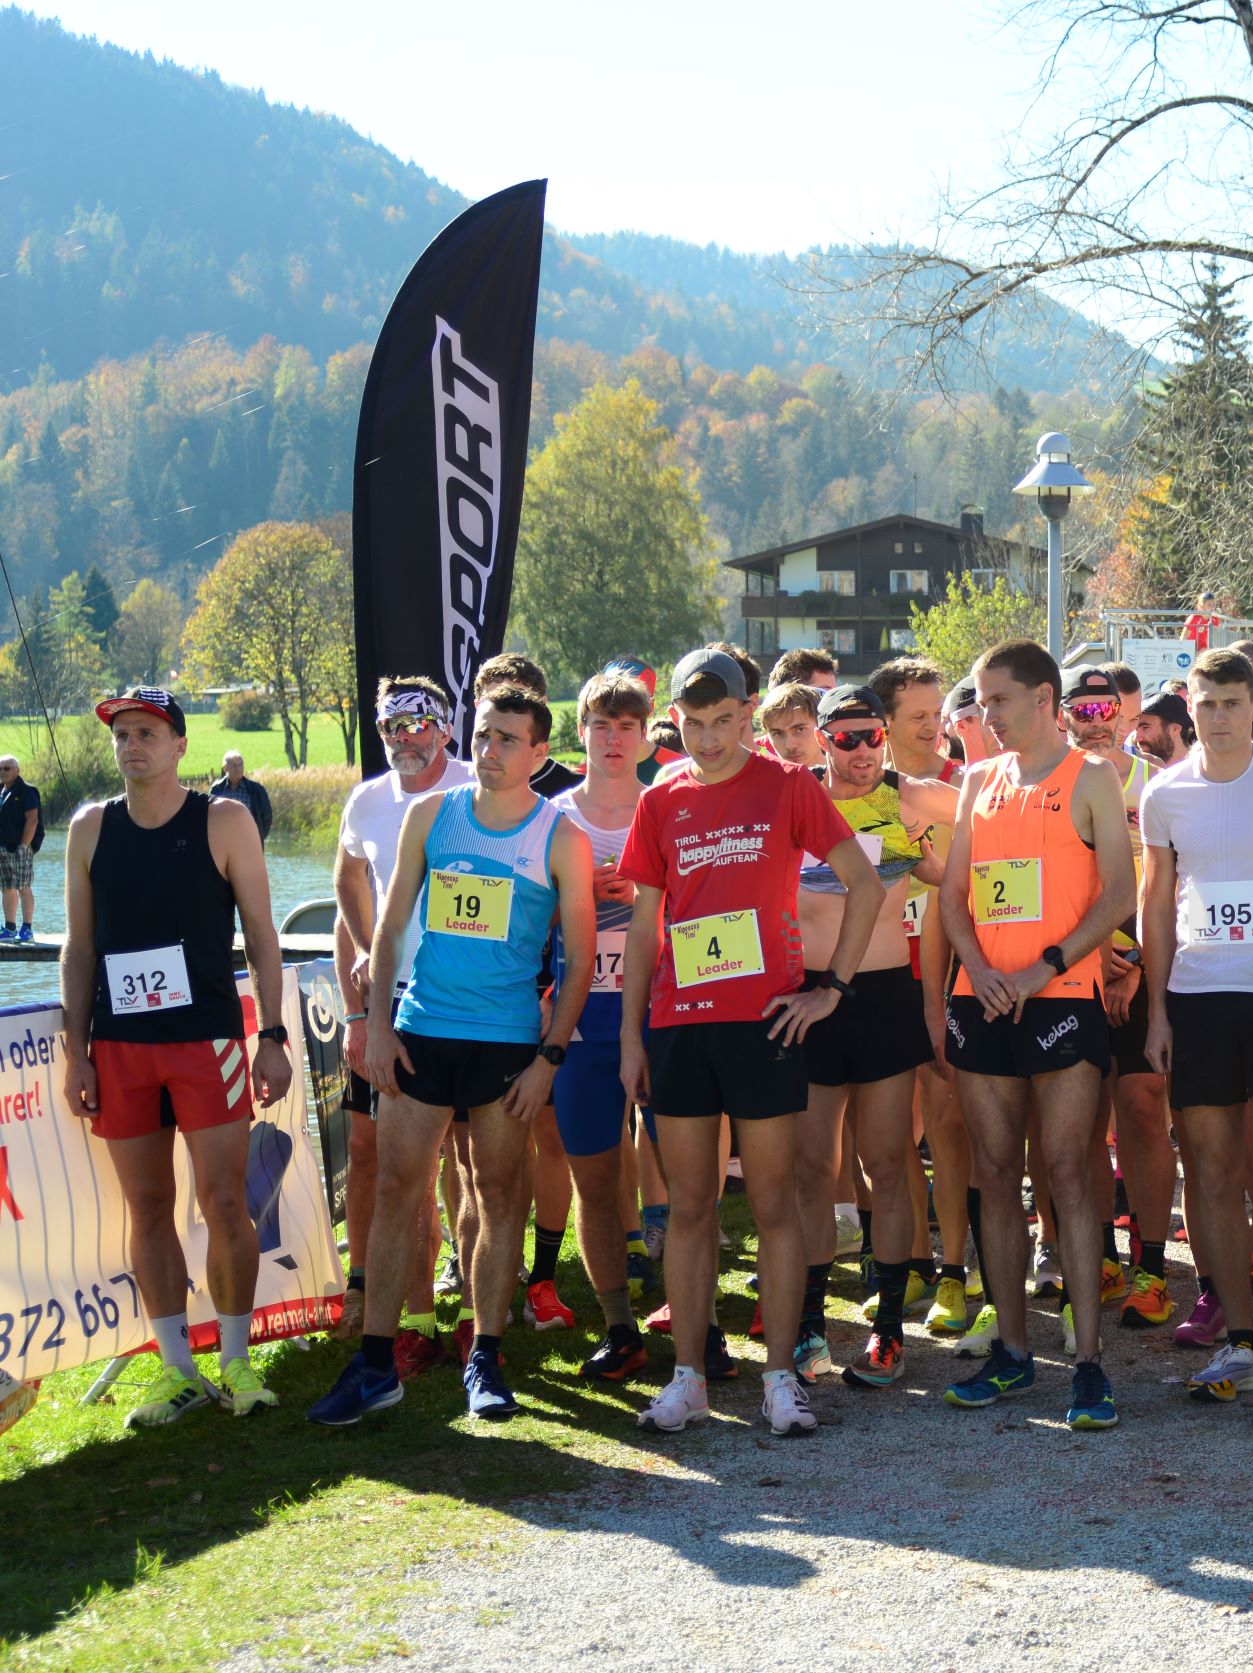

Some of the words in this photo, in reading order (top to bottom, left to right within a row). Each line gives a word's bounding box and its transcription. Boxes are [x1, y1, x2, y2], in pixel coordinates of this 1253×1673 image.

[674, 834, 702, 848] TIROL
[993, 880, 1006, 904] 2
[453, 894, 481, 919] 19
[987, 904, 1023, 919] Leader
[1206, 903, 1252, 926] 195
[446, 917, 490, 933] Leader
[707, 936, 722, 960] 4
[697, 959, 743, 977] Leader
[122, 970, 168, 996] 312
[944, 1007, 966, 1049] kelag
[1036, 1014, 1079, 1051] kelag
[9, 1028, 55, 1070] oder
